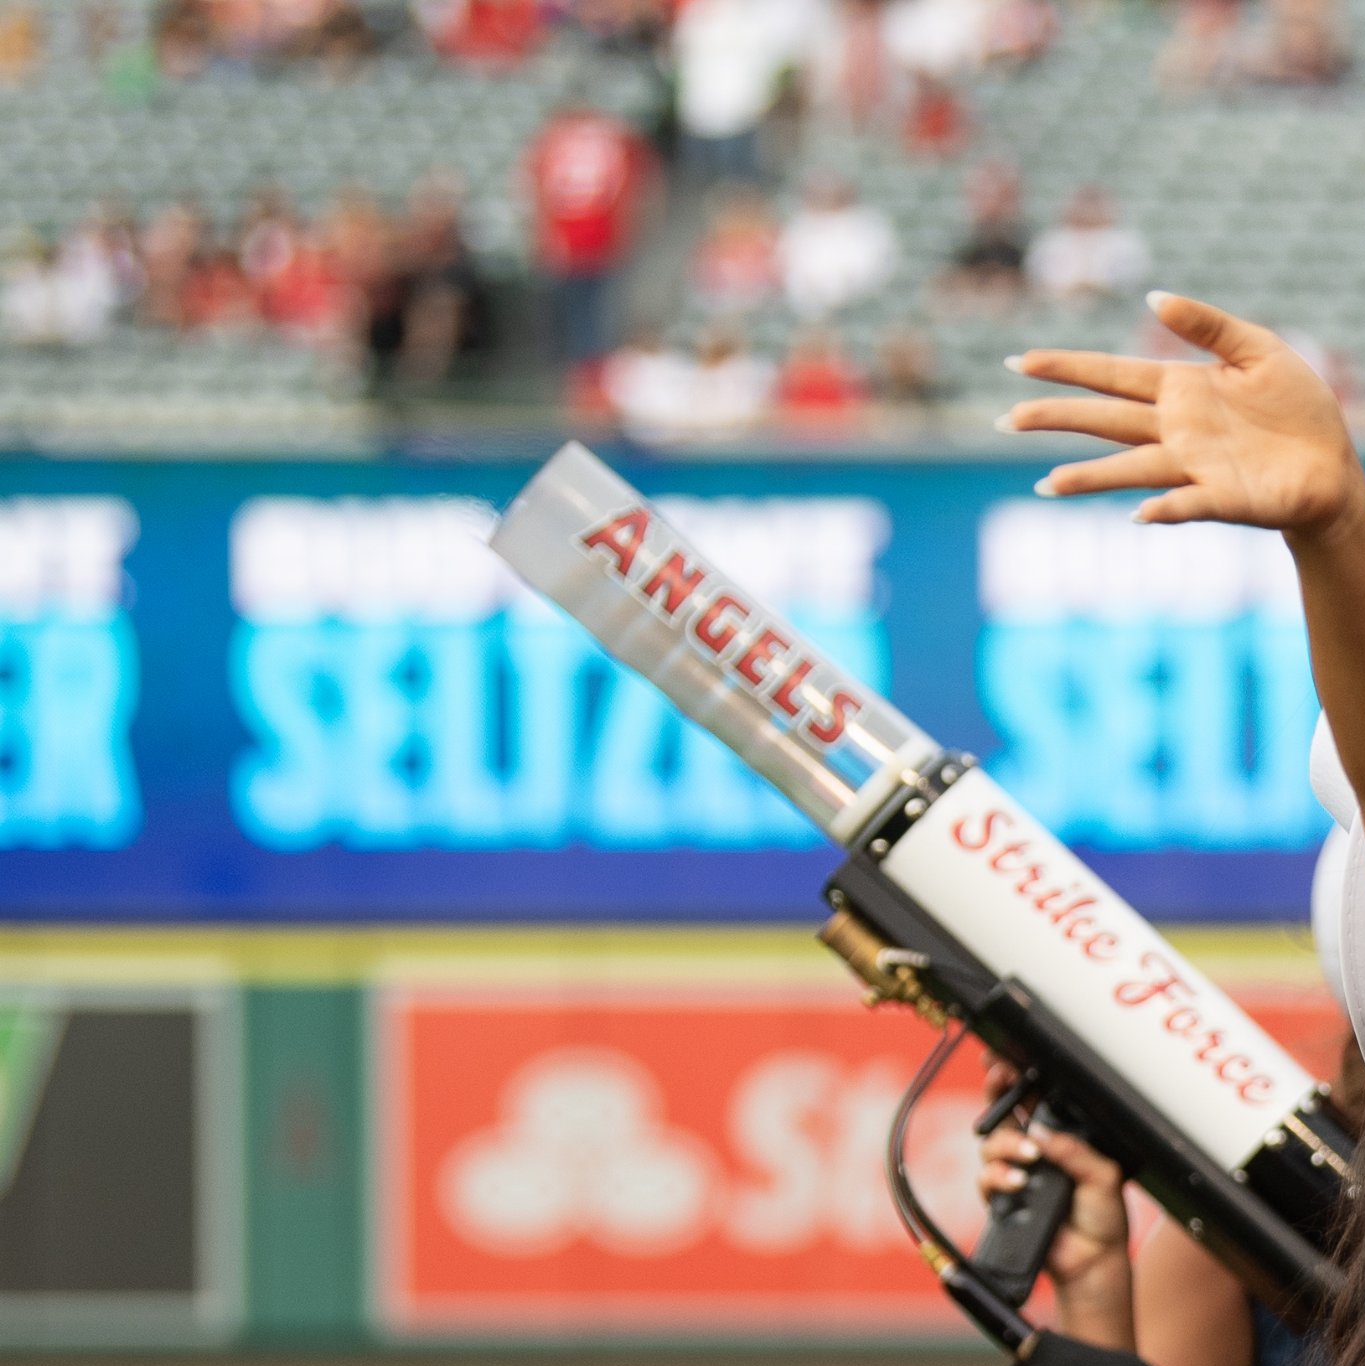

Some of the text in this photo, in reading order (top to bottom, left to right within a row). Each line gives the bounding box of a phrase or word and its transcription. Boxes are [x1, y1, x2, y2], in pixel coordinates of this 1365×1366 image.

[578, 505, 864, 746] ANGELS
[950, 808, 1277, 1107] Strike Force
